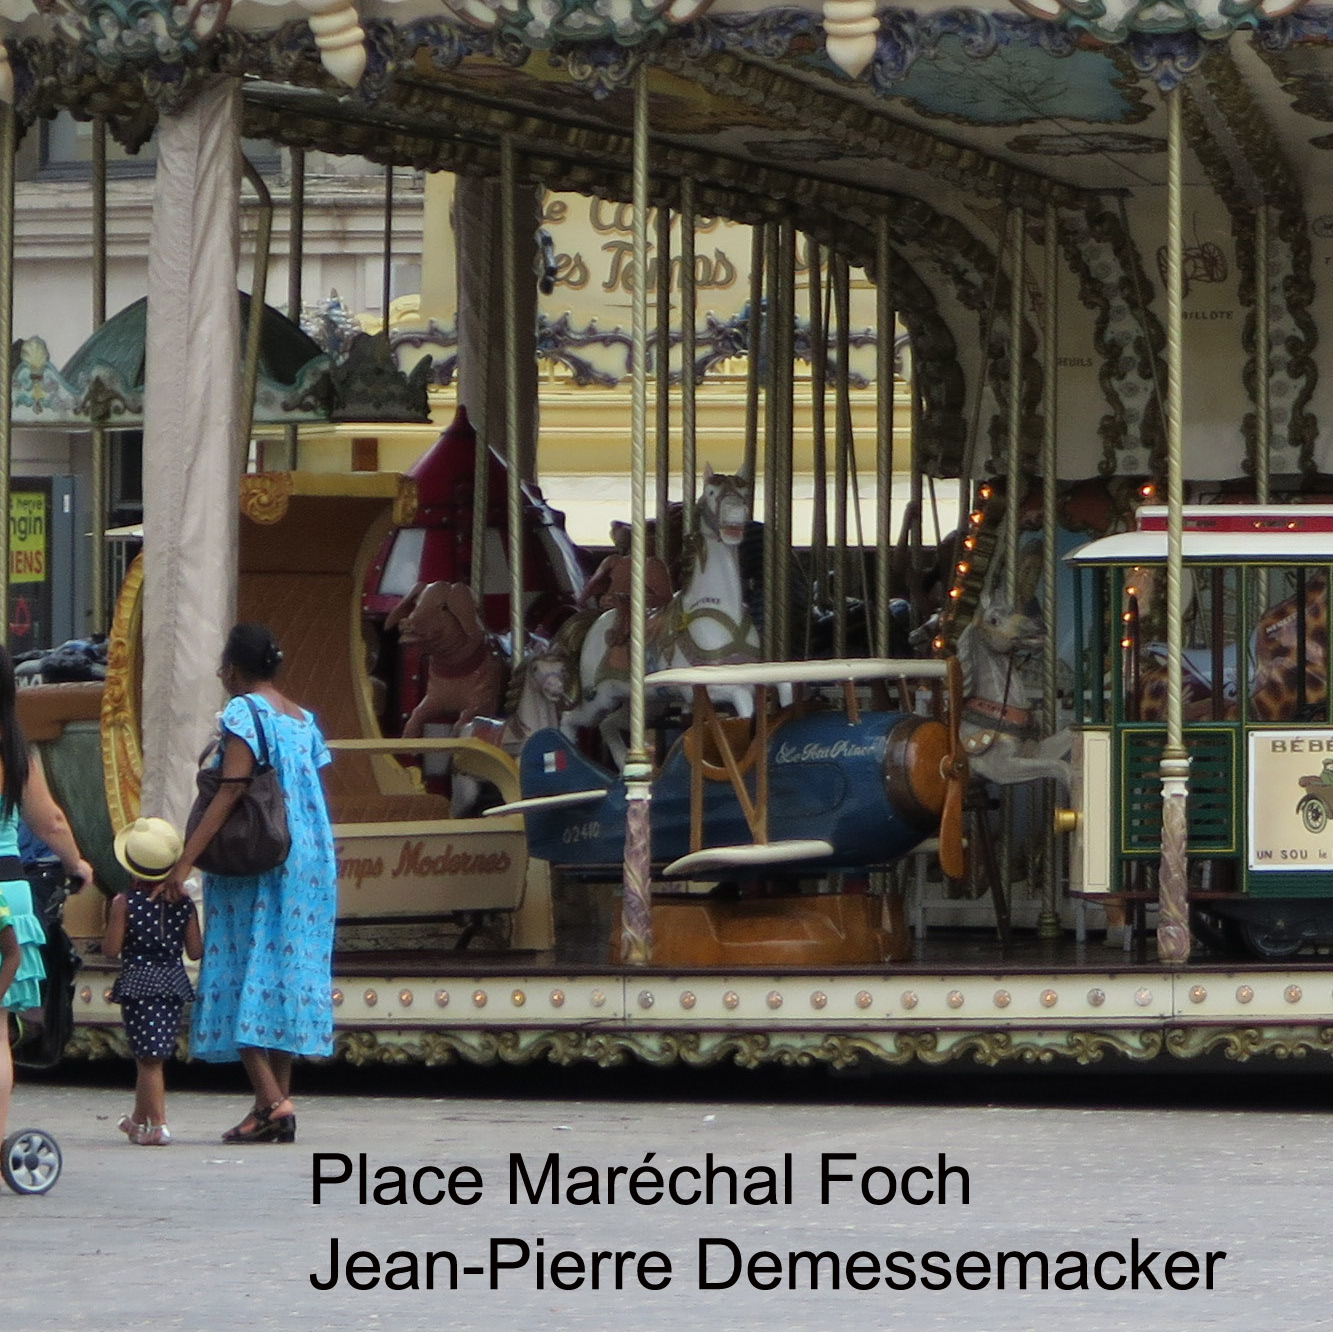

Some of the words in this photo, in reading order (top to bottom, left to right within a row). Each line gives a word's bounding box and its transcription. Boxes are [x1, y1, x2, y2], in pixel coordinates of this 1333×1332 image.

[392, 839, 512, 880] Modernes
[1256, 849, 1274, 860] UN
[1280, 849, 1309, 860] SOU
[1318, 848, 1328, 859] le
